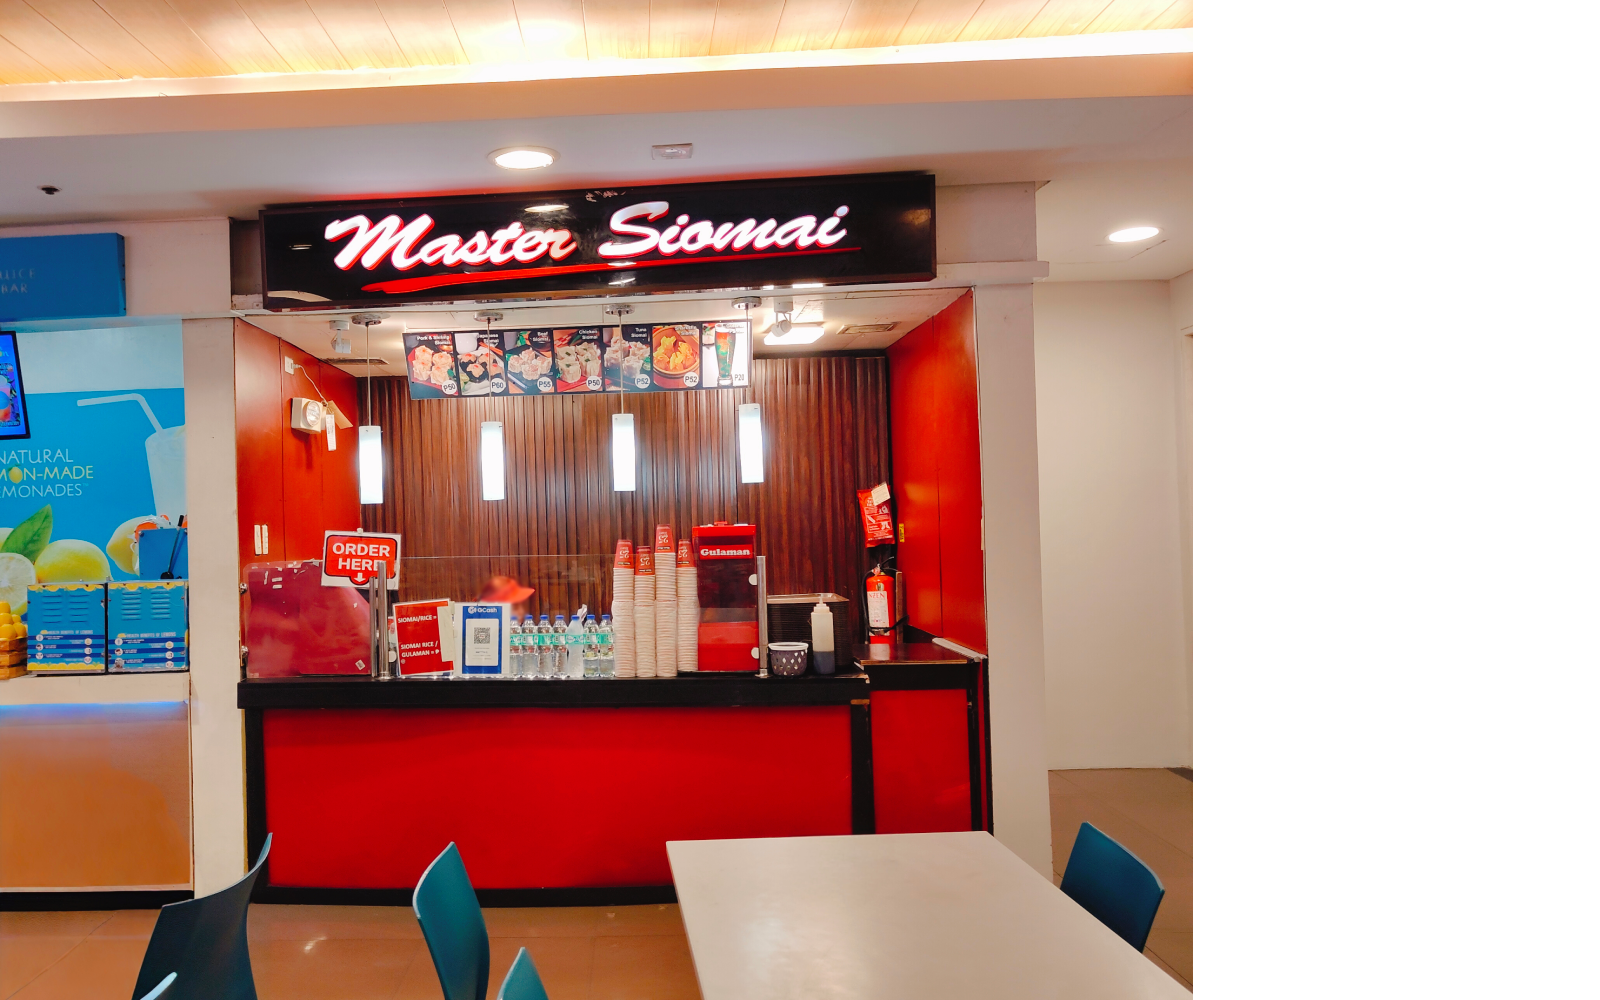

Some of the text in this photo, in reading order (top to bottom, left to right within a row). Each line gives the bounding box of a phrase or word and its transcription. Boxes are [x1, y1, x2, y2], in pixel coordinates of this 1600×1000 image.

[324, 201, 850, 271] Master Siomai
[1, 283, 28, 294] BAR
[0, 483, 82, 499] MONADES
[658, 535, 669, 544] 25
[332, 542, 391, 557] ORDER
[700, 548, 750, 556] Gulaman
[619, 550, 630, 559] 25
[640, 557, 650, 566] 25
[397, 615, 432, 623] SIOMAI/RICE
[401, 650, 430, 658] GULAMAN
